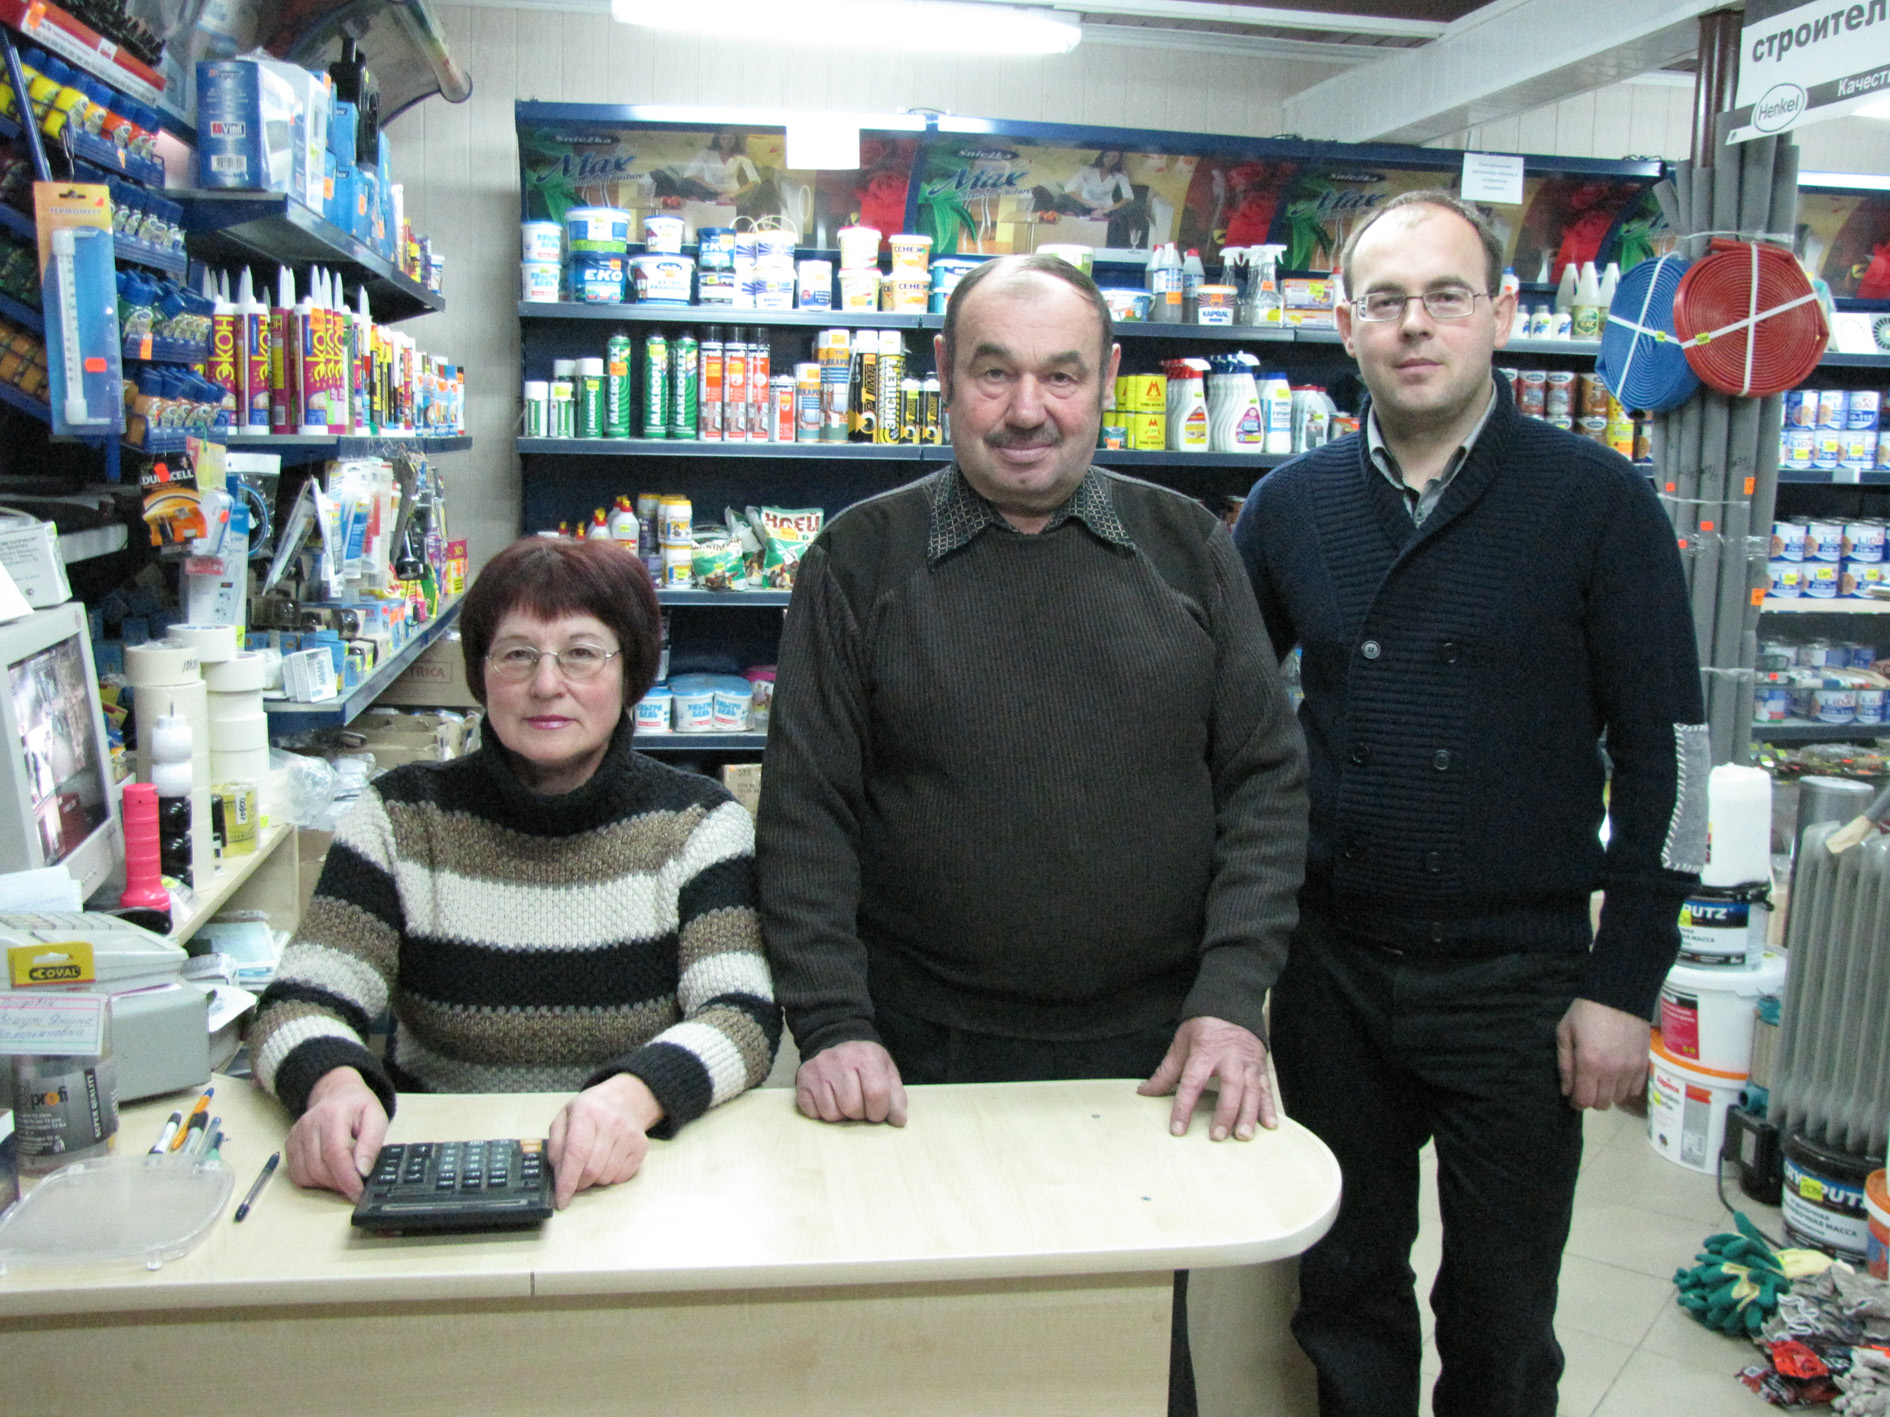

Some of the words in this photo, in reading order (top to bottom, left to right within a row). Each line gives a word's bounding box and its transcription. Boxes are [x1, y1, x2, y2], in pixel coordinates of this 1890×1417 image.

[1752, 0, 1890, 63] строител
[1758, 94, 1800, 121] Henkel
[535, 152, 638, 183] Max
[927, 167, 1029, 197] Max
[584, 269, 623, 282] EKO
[609, 346, 620, 424] MAKROEX
[676, 347, 687, 426] MAKROFLEX
[885, 358, 898, 430] ЭКСПЕРТ
[141, 468, 195, 486] DUCELL
[403, 666, 446, 679] TRICA
[32, 966, 79, 979] COVAL
[30, 1084, 70, 1110] profi
[86, 1074, 98, 1110] QUALITY
[91, 1110, 102, 1139] SUPER
